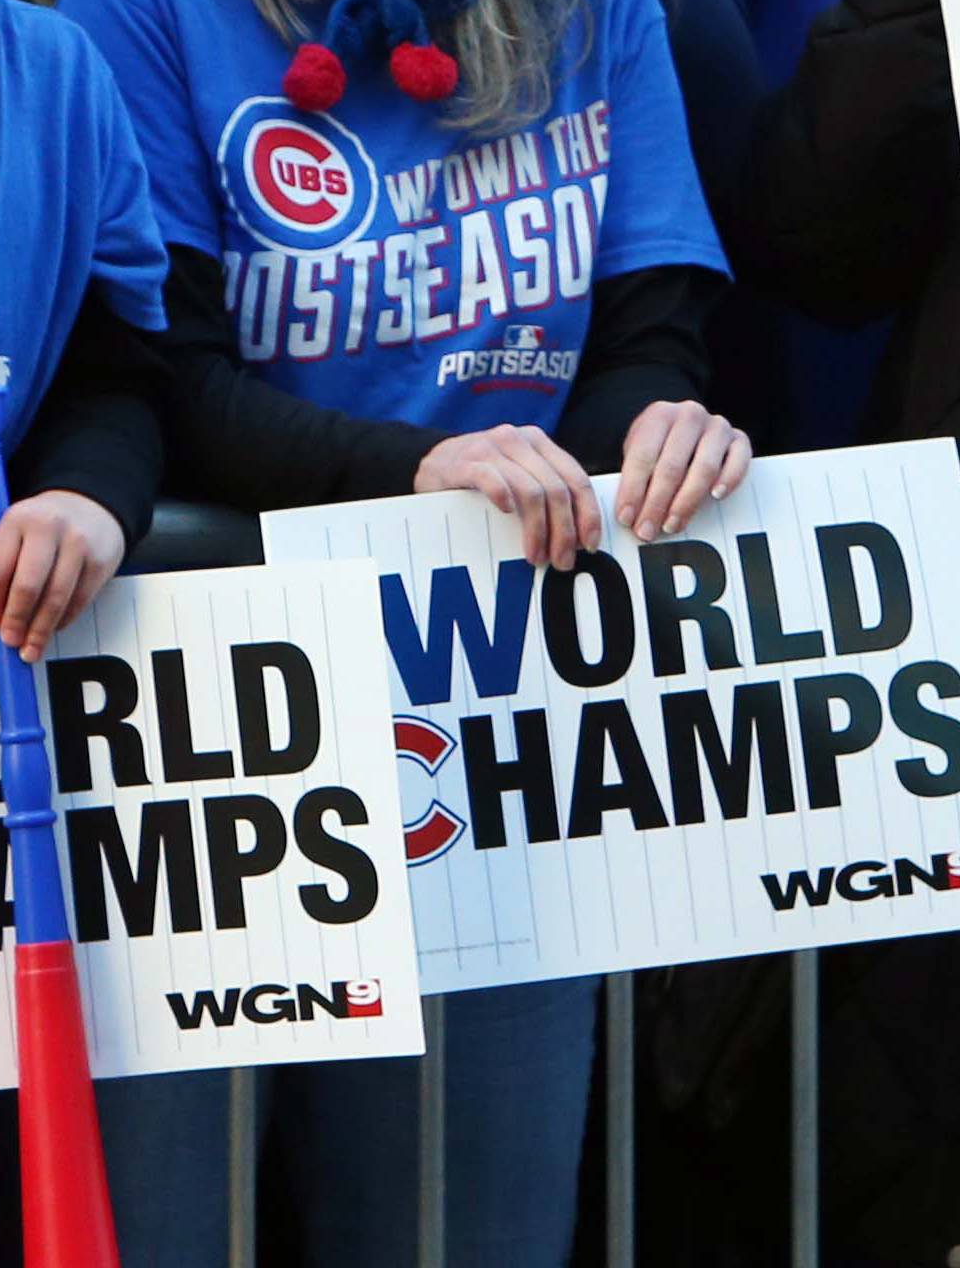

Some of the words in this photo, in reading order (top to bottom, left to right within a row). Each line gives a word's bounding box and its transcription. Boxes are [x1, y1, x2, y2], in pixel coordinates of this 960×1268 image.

[443, 132, 547, 212] OWN
[545, 99, 611, 179] THE
[379, 521, 913, 707] WORLD
[165, 978, 383, 1030] WGN9
